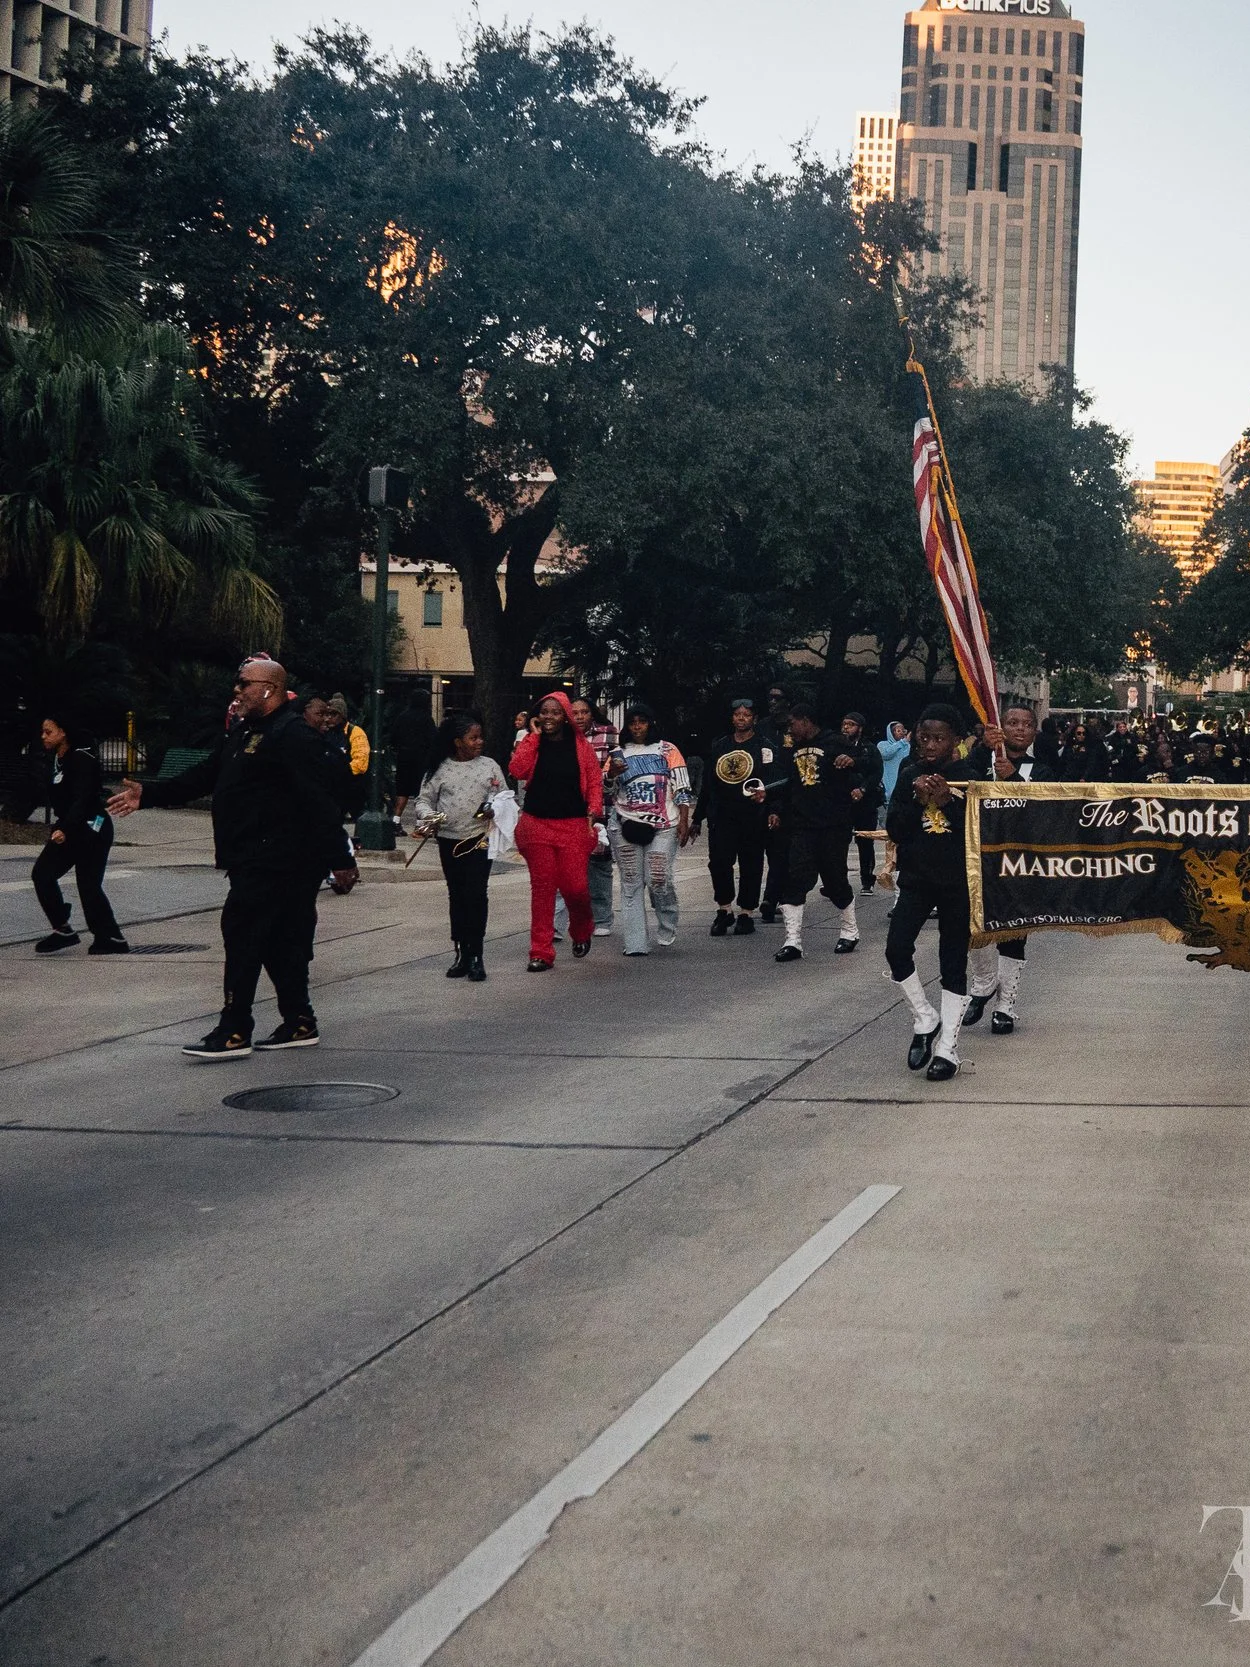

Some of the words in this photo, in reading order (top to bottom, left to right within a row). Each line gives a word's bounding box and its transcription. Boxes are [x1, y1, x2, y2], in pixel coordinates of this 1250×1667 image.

[1079, 800, 1129, 828] The
[1131, 798, 1239, 838] Roots
[998, 852, 1156, 879] MARCHING
